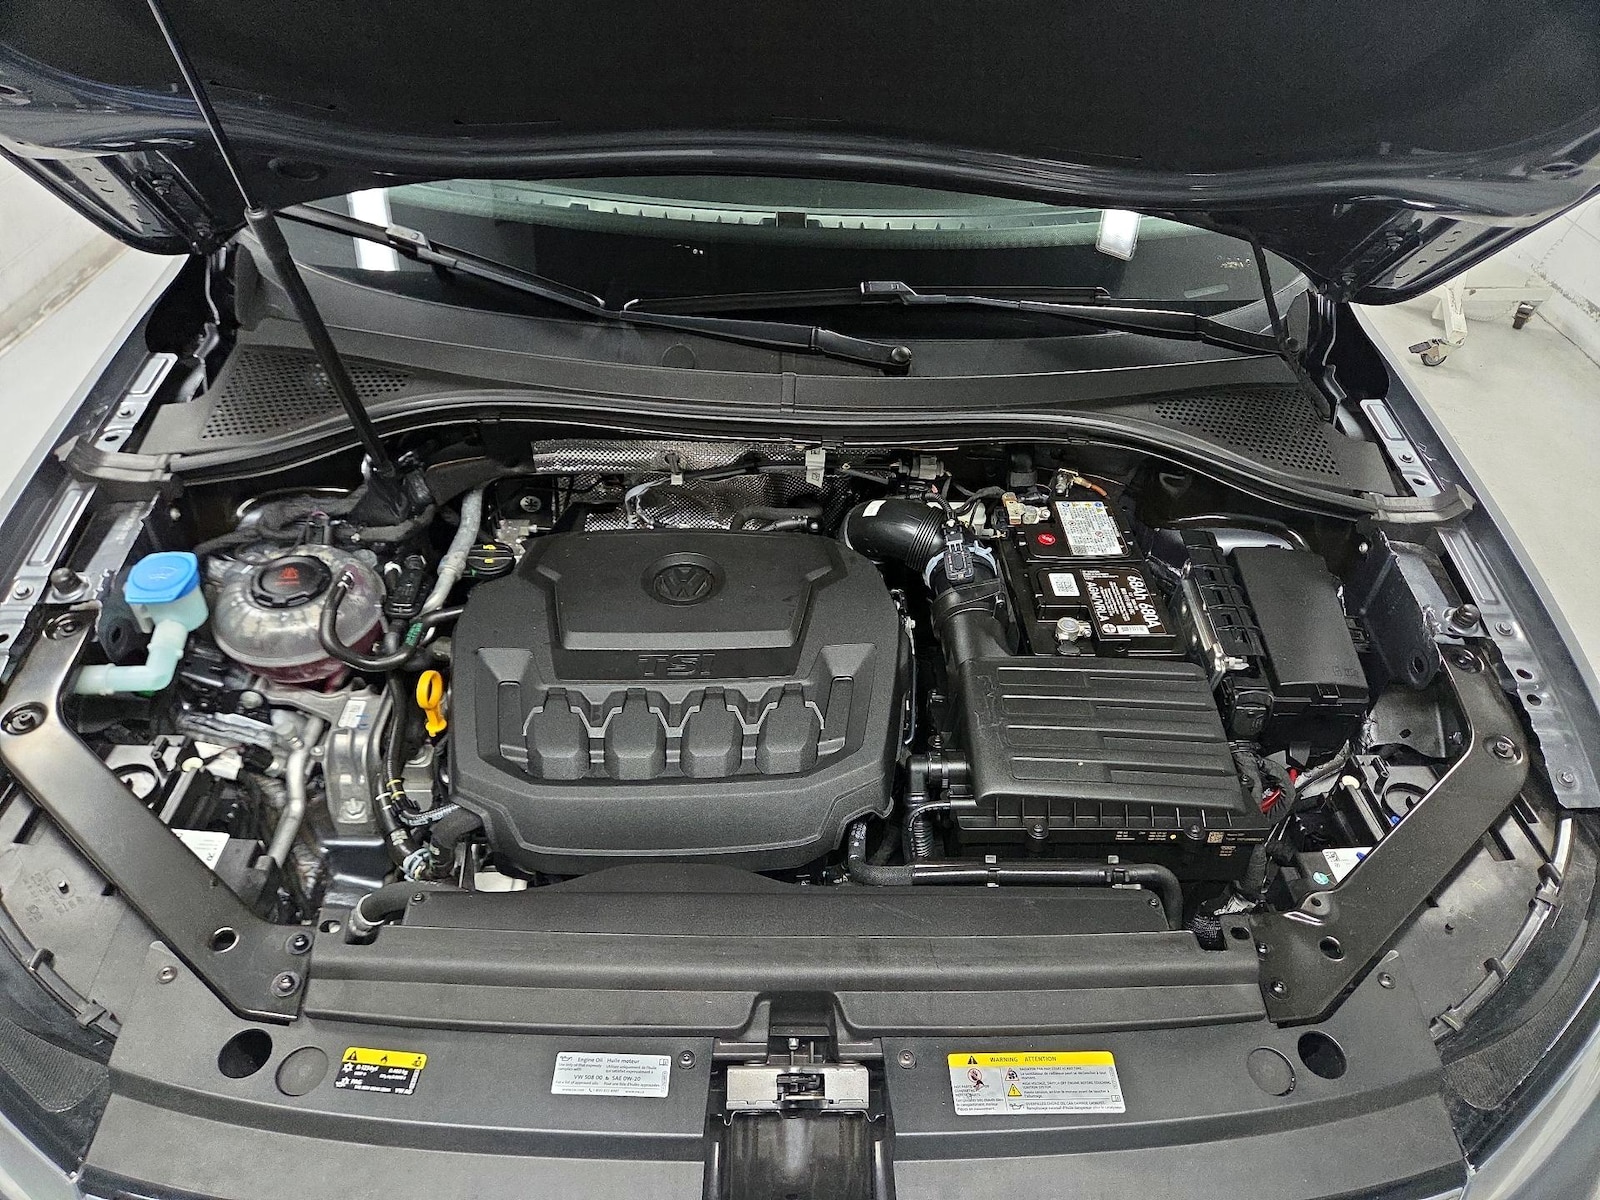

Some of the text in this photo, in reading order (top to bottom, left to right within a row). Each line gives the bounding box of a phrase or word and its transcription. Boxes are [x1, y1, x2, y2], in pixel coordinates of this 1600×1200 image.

[1127, 575, 1149, 601] 68Ah
[1138, 602, 1162, 629] 680A
[638, 653, 716, 677] TSI
